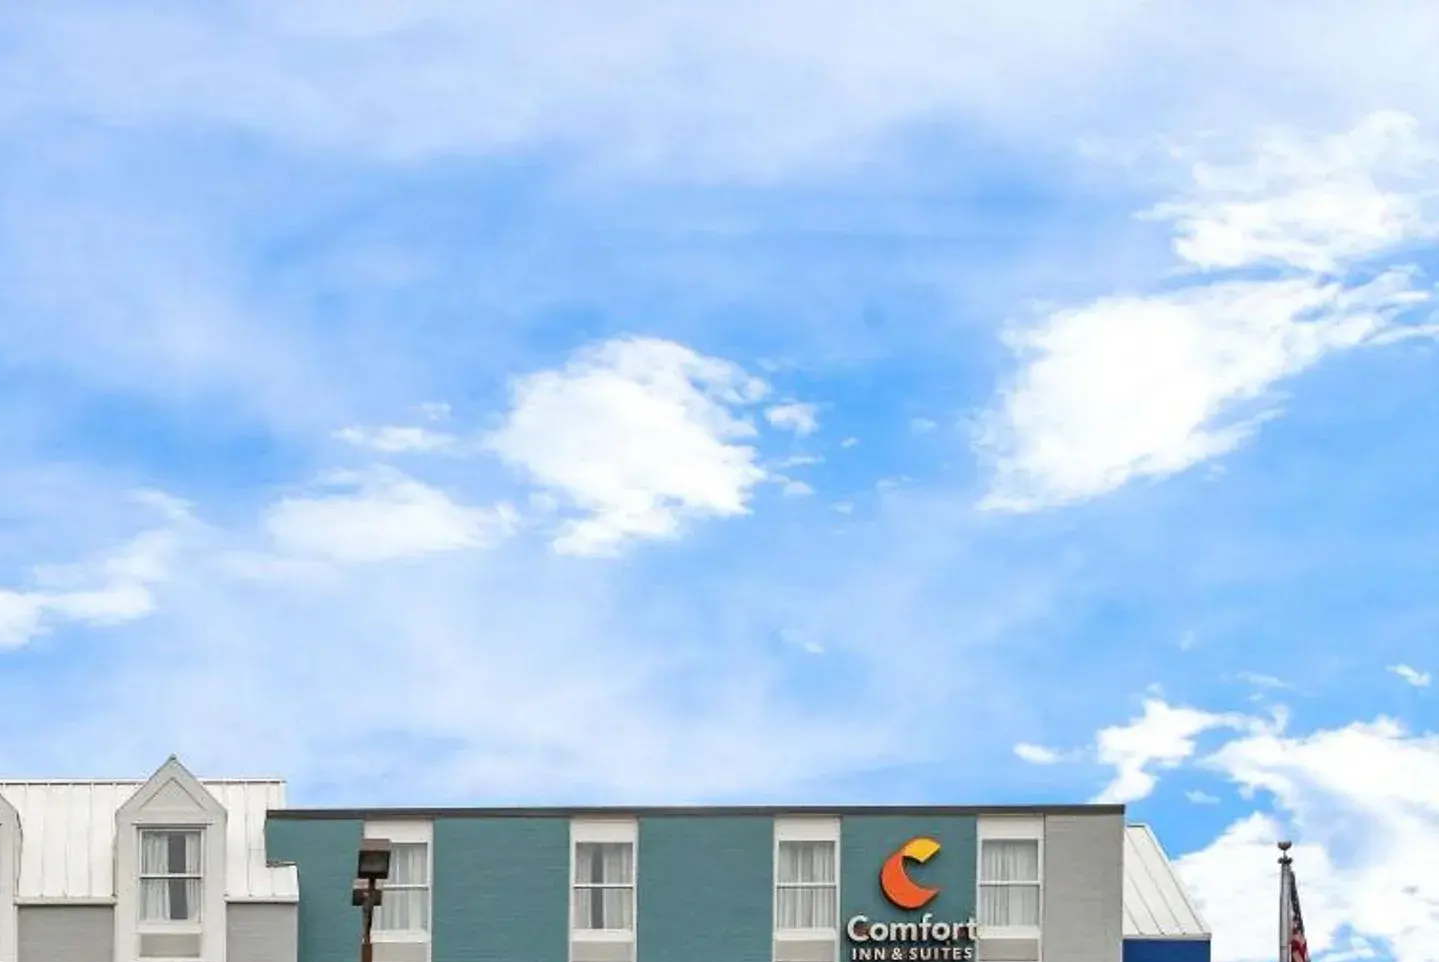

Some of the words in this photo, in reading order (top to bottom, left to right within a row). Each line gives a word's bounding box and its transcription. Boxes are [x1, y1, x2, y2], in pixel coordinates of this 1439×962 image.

[847, 913, 980, 942] Comfort
[852, 947, 886, 961] INN
[891, 947, 903, 961] &
[908, 946, 973, 960] SUITES
